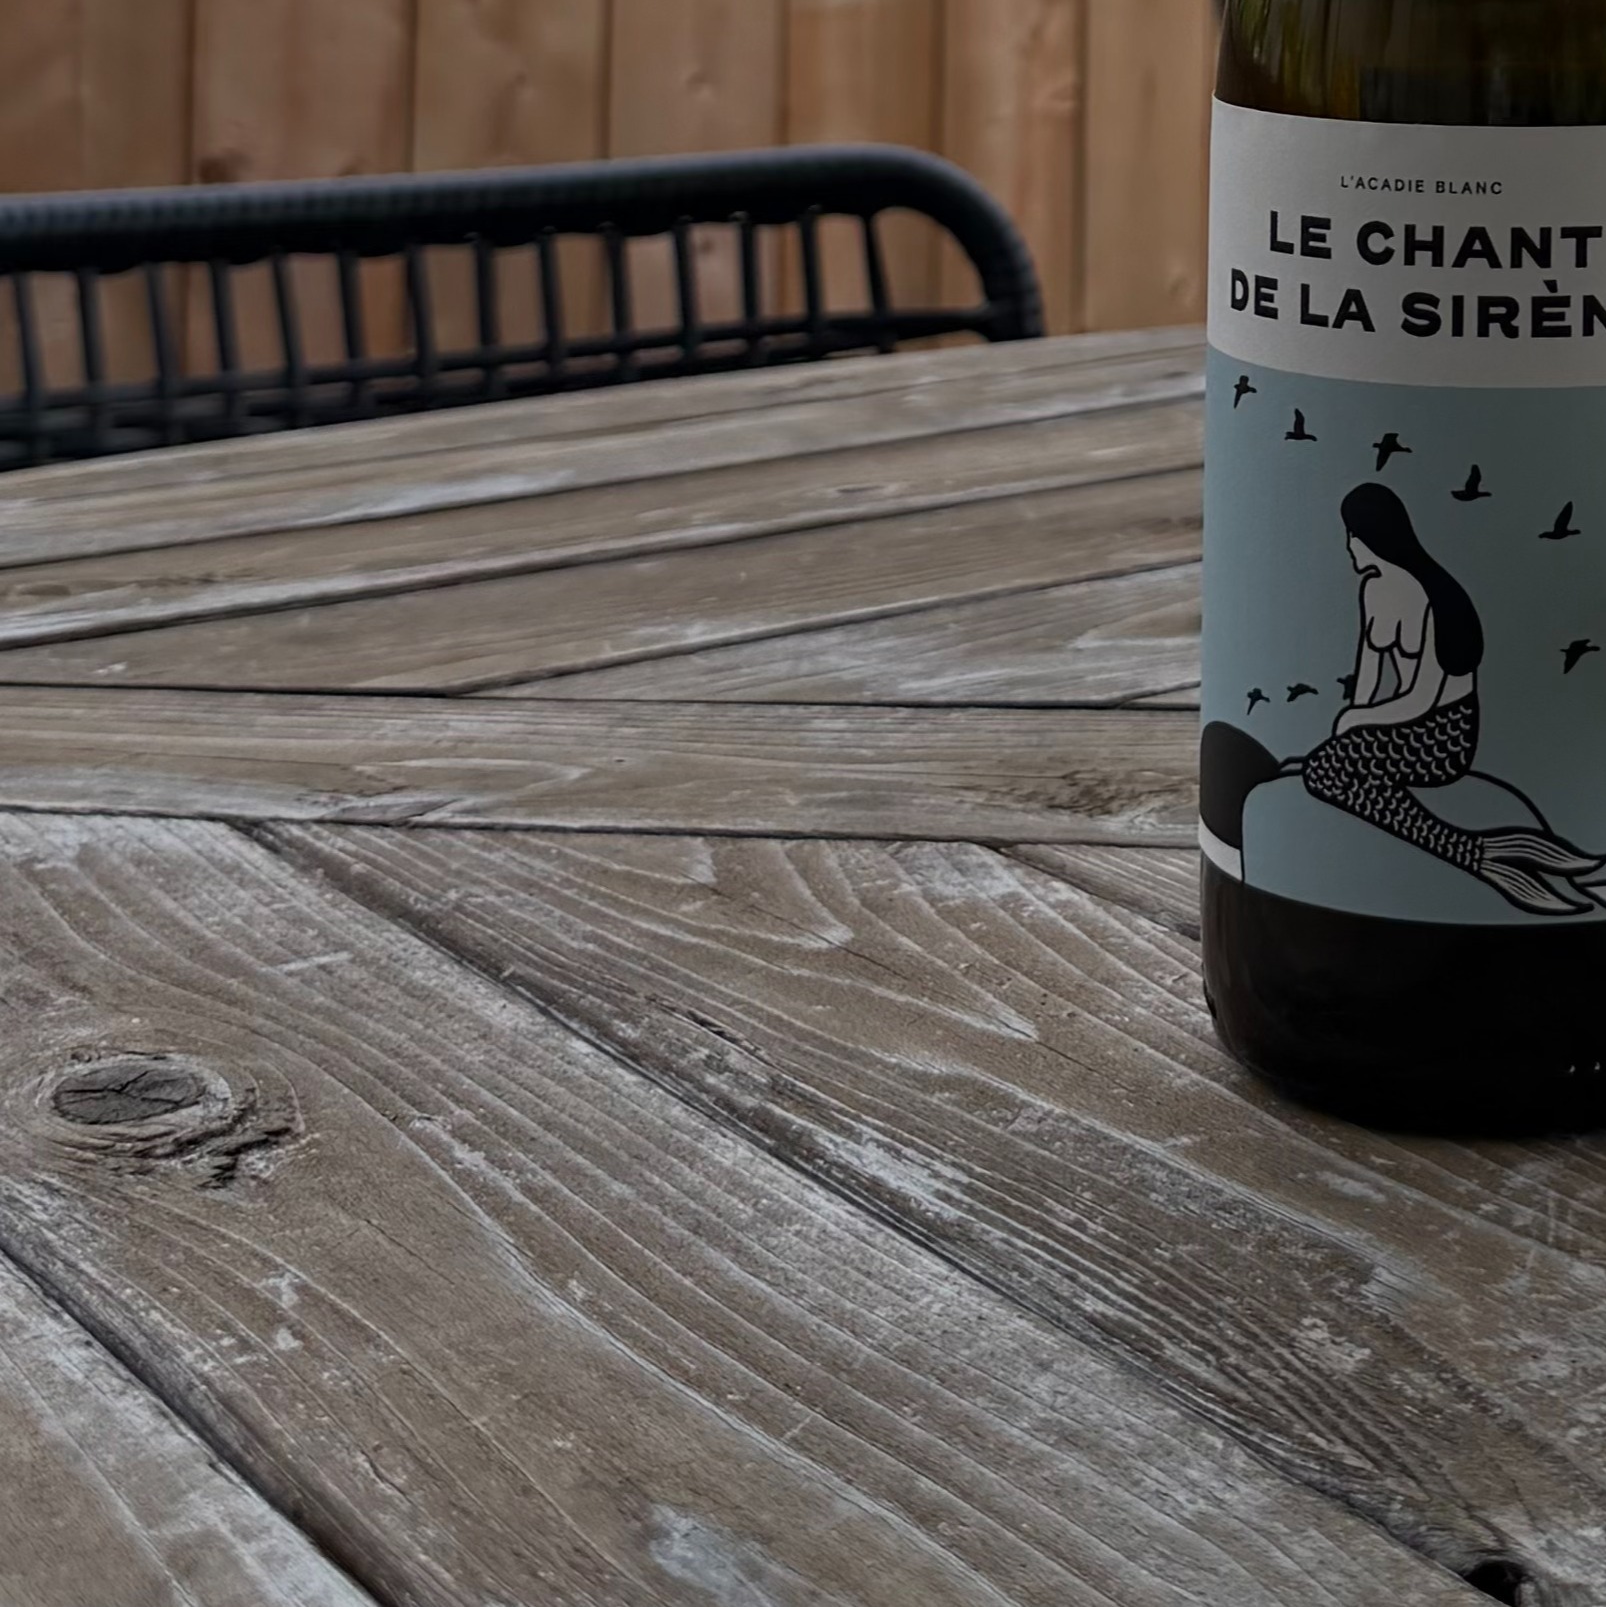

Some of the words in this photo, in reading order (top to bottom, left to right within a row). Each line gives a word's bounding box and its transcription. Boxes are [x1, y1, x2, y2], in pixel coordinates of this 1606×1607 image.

[1340, 175, 1425, 193] L'ACADIE
[1435, 180, 1503, 195] BLANC
[1269, 210, 1332, 260] LE
[1356, 220, 1603, 269] CHANT
[1231, 268, 1279, 320] DE
[1300, 283, 1376, 333] LA
